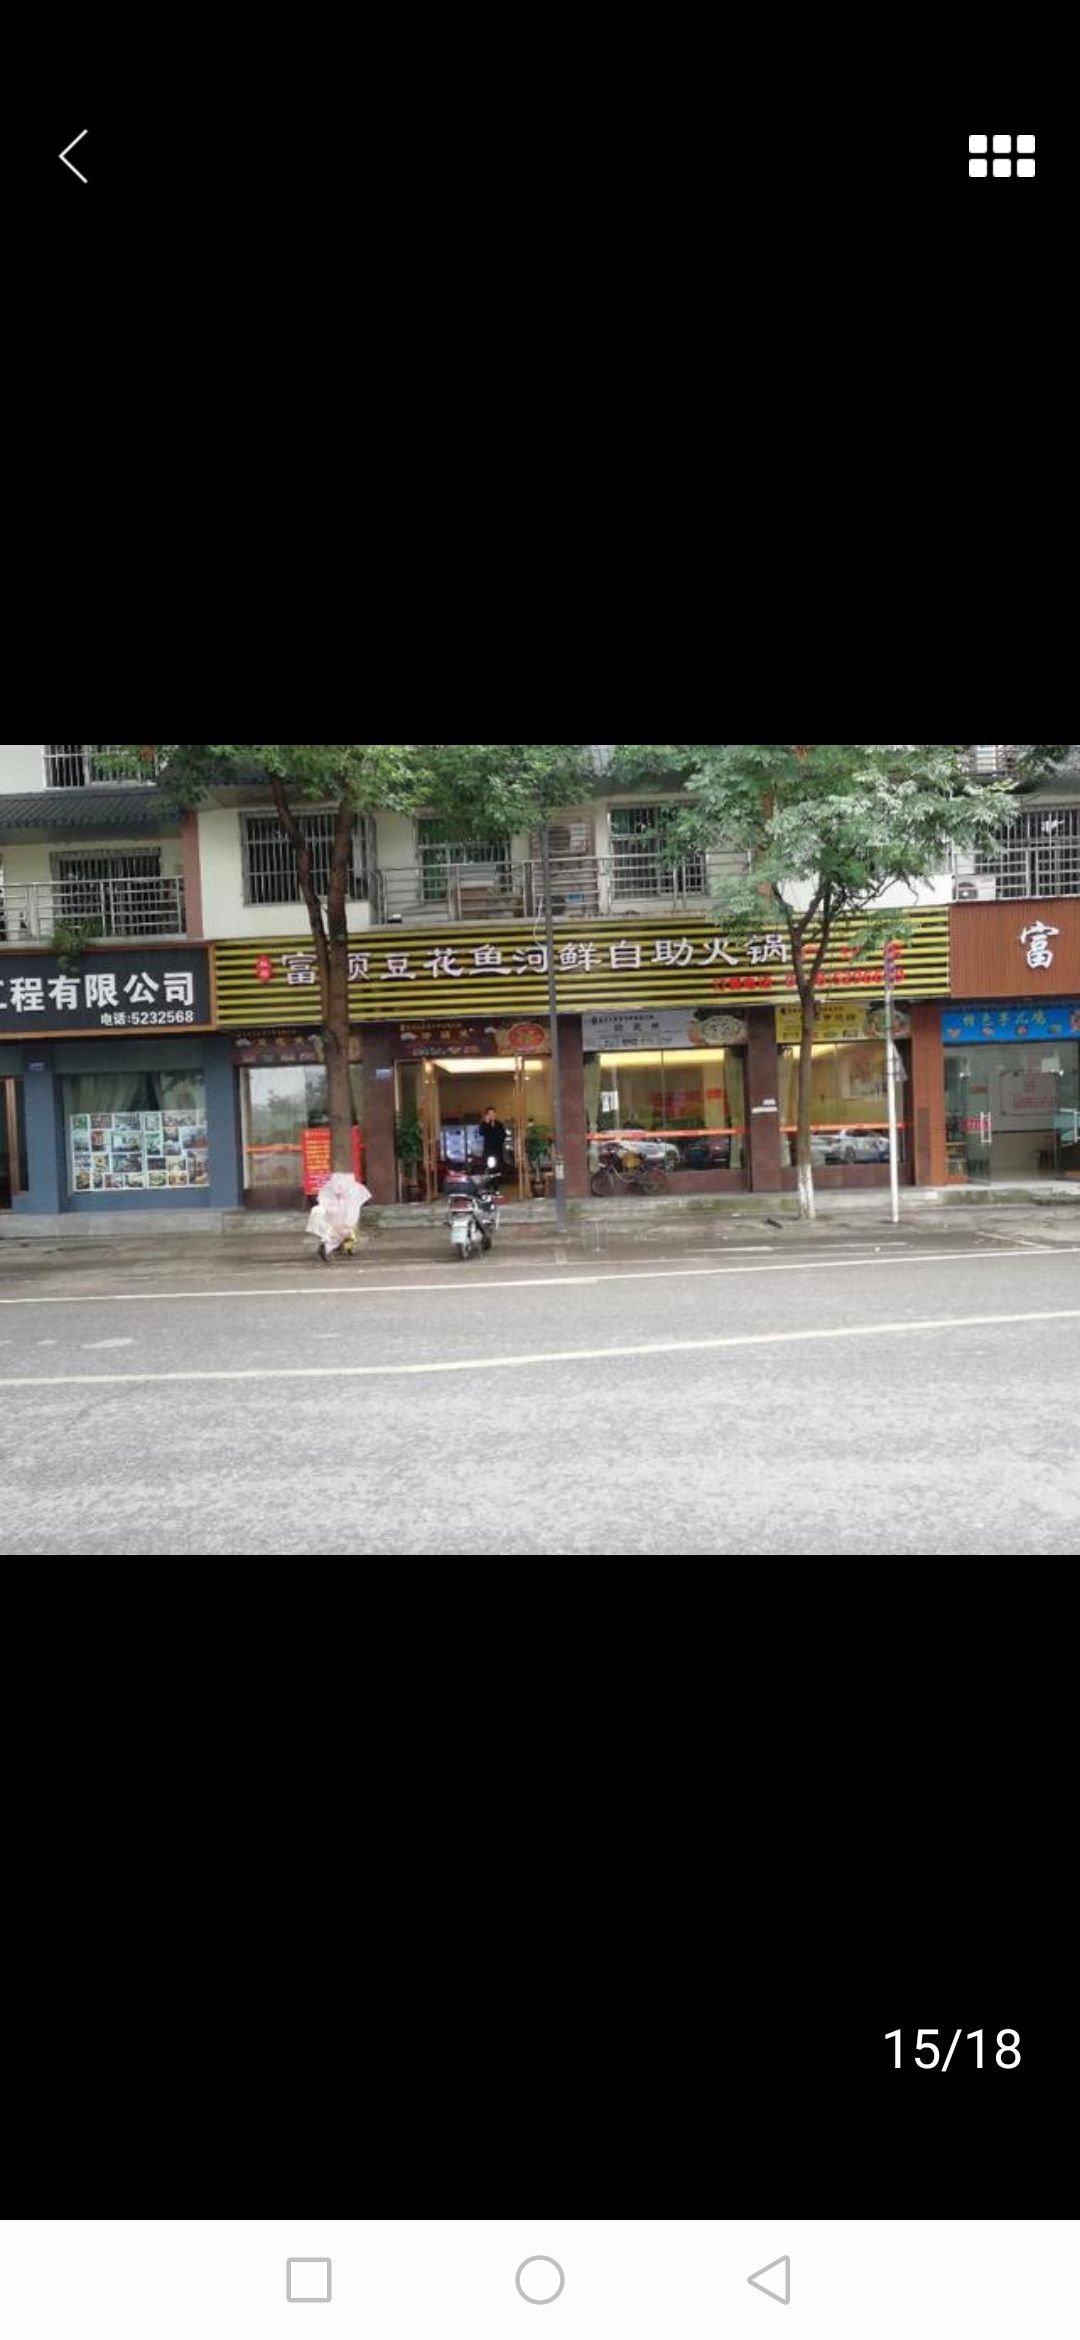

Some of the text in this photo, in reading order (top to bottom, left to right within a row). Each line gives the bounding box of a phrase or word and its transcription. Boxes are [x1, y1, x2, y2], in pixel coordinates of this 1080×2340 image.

[1020, 920, 1060, 969] 富
[0, 972, 195, 1013] 程有限公司
[100, 1010, 194, 1027] 电话:5232568
